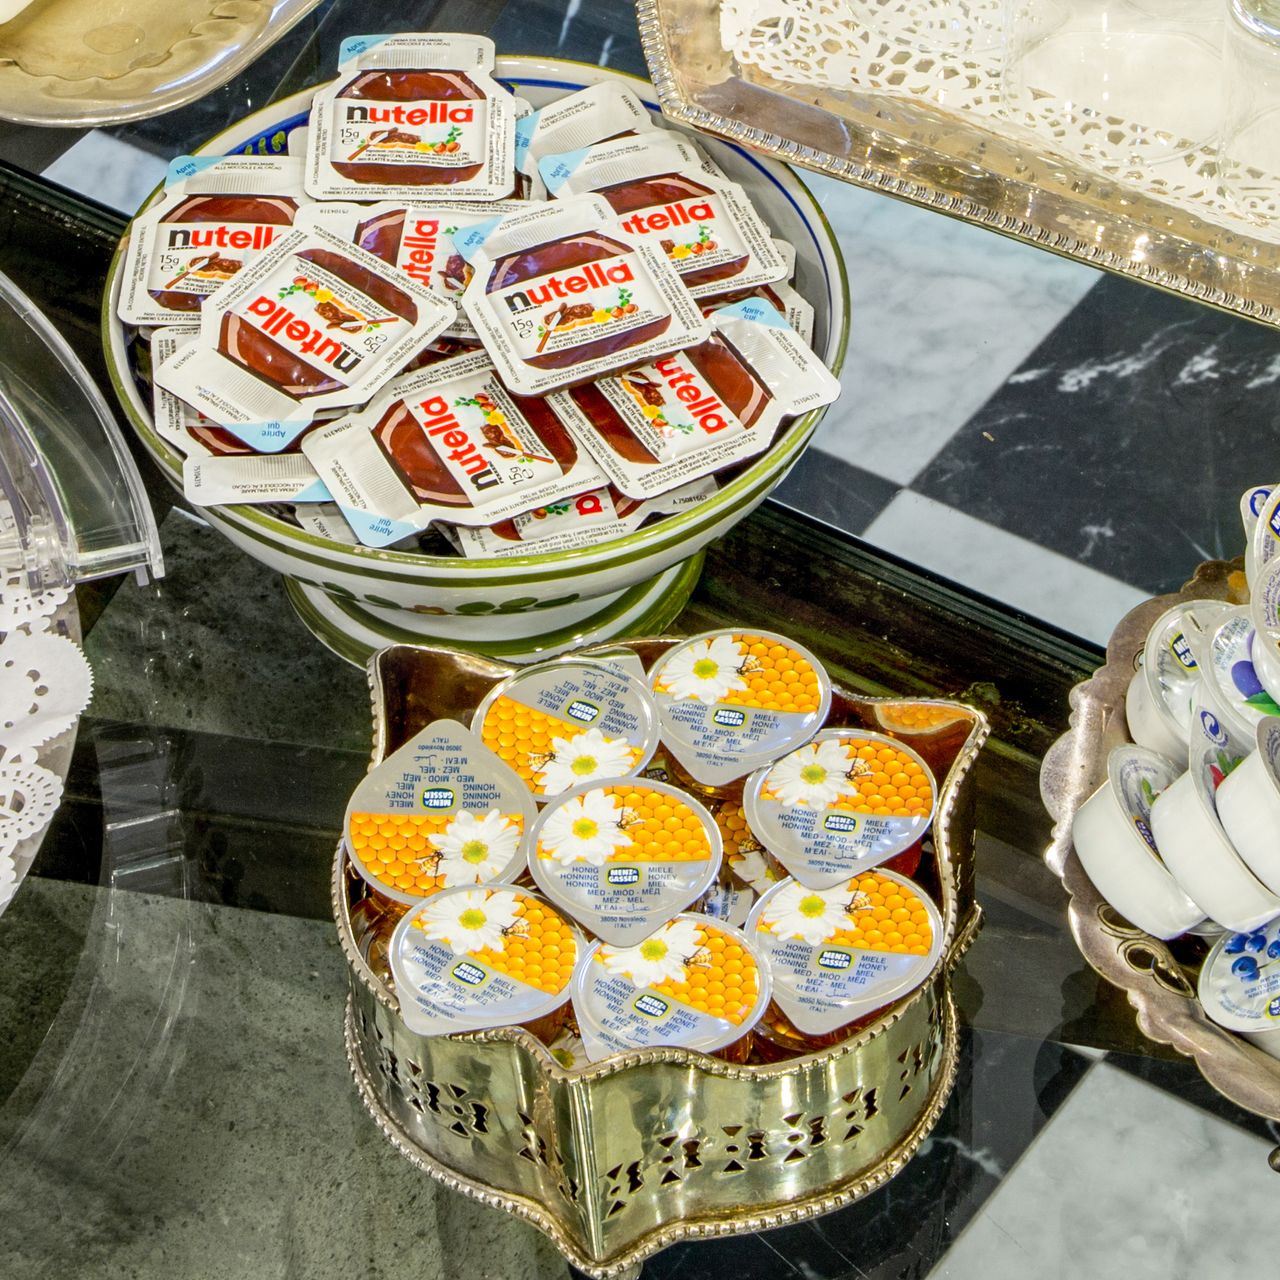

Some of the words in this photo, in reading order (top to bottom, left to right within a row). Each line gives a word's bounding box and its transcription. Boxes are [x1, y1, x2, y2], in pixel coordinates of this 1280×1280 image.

[346, 103, 473, 126] nutella
[340, 128, 359, 138] 15g
[169, 224, 283, 250] nutell
[159, 254, 179, 266] 15g
[503, 261, 635, 314] nutella
[510, 319, 533, 332] 15g
[246, 295, 364, 376] nutella
[419, 395, 500, 493] nutella
[715, 716, 742, 725] GASSER
[825, 822, 854, 831] GASSER
[864, 827, 893, 835] HONEY
[786, 944, 813, 953] HONIG
[819, 959, 849, 967] GASSER
